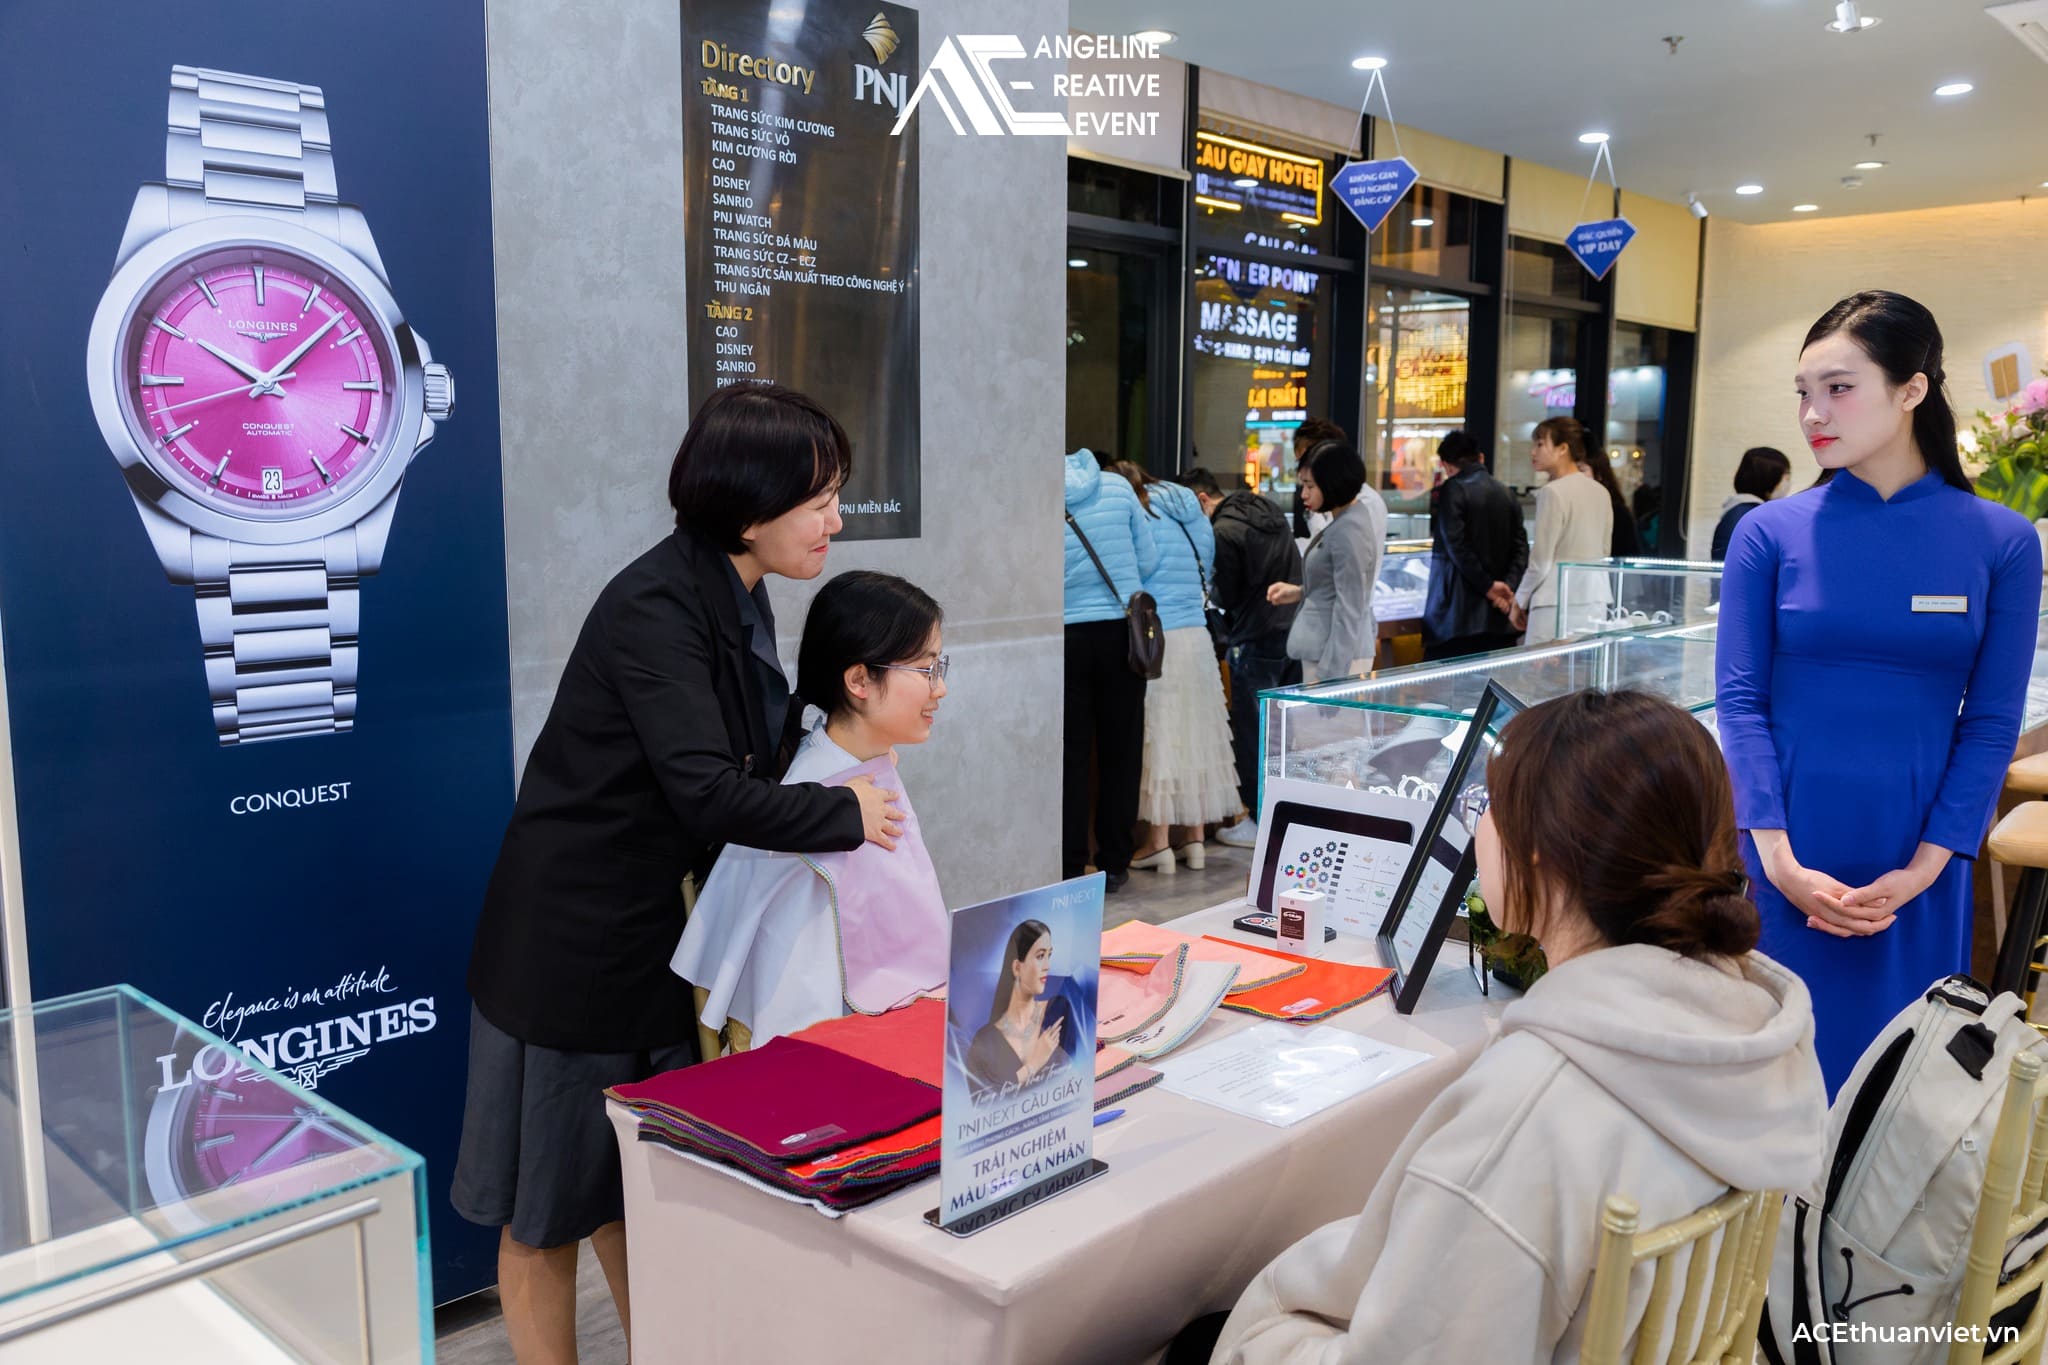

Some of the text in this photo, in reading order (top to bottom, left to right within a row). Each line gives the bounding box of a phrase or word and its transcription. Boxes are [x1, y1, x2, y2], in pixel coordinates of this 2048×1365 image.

[701, 40, 815, 95] Directory
[741, 88, 750, 102] 1
[854, 64, 908, 118] PNJ
[711, 103, 835, 137] TRANG SỨC KIM CƯƠNG
[711, 121, 790, 146] TRANG SỨC VỎ
[712, 139, 797, 165] KIM CƯƠNG RỜI
[712, 157, 735, 172] CAO
[1228, 150, 1267, 179] GIAY
[1269, 158, 1318, 191] HOTEL
[713, 175, 750, 191] DISNEY
[713, 192, 753, 209] SANRIO
[713, 210, 772, 228] PNJ WATCH
[713, 228, 817, 251] TRANG SỨC ĐÁ MÀU
[1578, 240, 1622, 255] VIP DAY
[714, 245, 750, 260] TRANG
[753, 248, 774, 262] SỨC
[776, 253, 789, 265] CZ
[799, 254, 817, 268] ECZ
[714, 263, 905, 294] TRANG SỨC SẢN XUẤT THEO CÔNG NGHỆ Ý
[715, 280, 771, 297] THU NGÂN
[228, 319, 298, 332] LONGINES
[744, 307, 753, 321] 2
[715, 326, 738, 338] CAO
[716, 343, 753, 356] DISNEY
[716, 360, 756, 373] SANRIO
[264, 471, 281, 491] 23
[839, 499, 901, 514] PNJ MIỀN BẮC
[230, 782, 351, 815] CONQUEST
[202, 964, 399, 1043] Elegance is an attitude
[156, 996, 437, 1092] LONGINES
[1021, 1092, 1049, 1114] CẦU
[1052, 1075, 1083, 1102] GIẤY
[972, 1150, 1005, 1178] TRẢI
[1009, 1128, 1066, 1164] NGHIỆM
[950, 1183, 986, 1213] MÀU
[1022, 1160, 1041, 1180] CÁ
[1045, 1140, 1085, 1171] NHÂN
